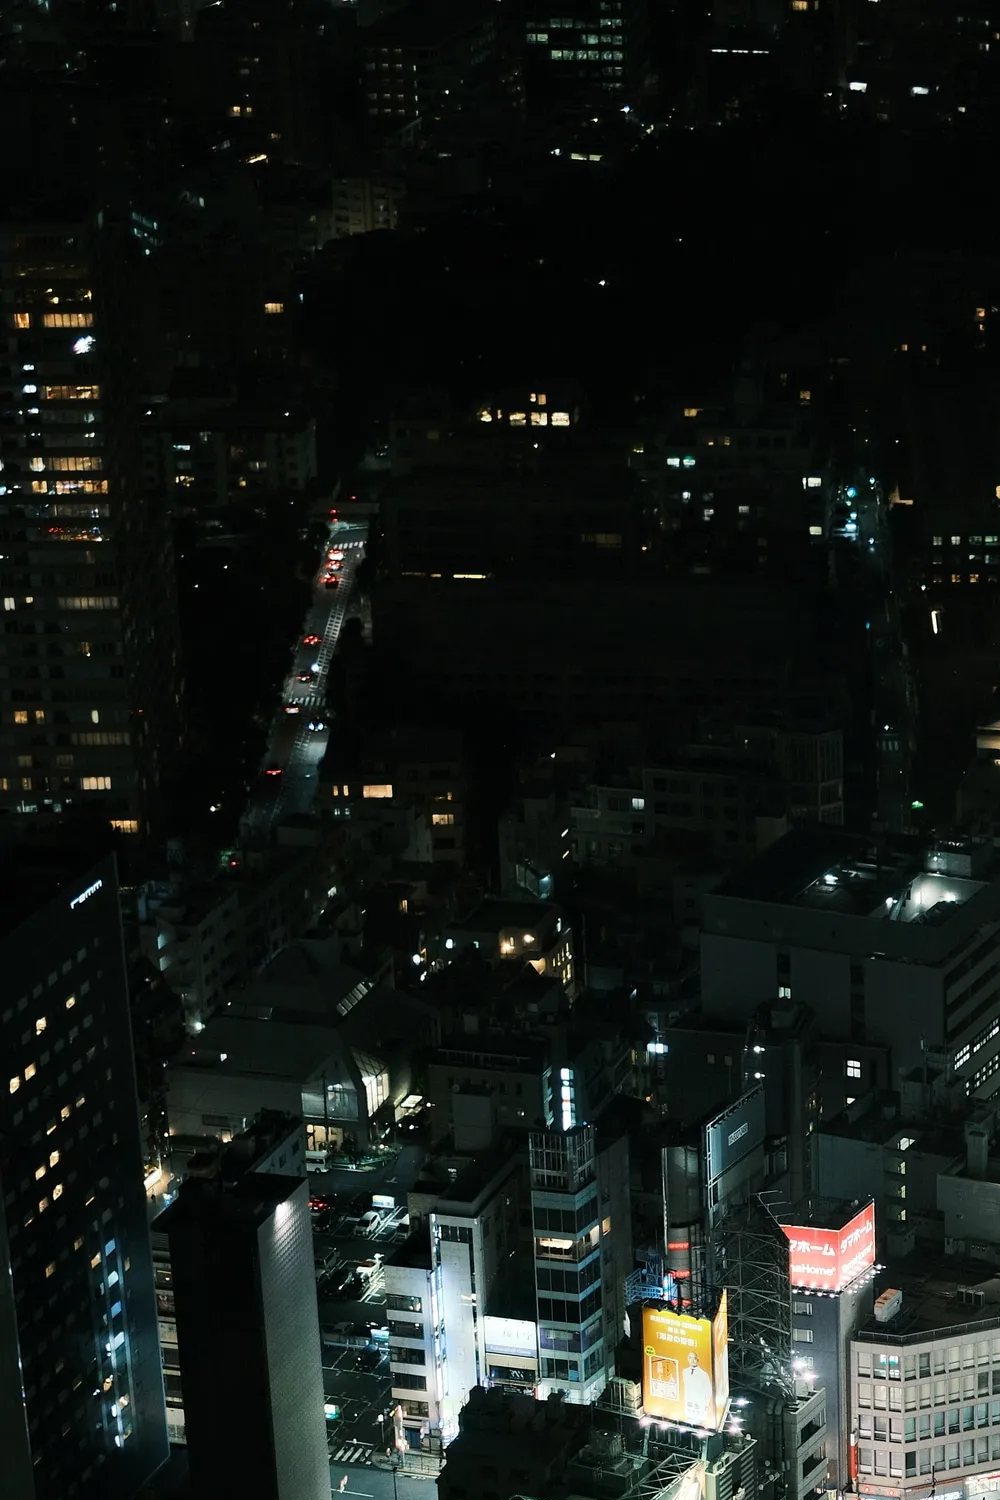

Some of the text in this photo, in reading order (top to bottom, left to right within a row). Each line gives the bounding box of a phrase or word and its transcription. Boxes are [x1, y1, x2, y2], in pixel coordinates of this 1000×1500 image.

[789, 1239, 836, 1257] マホーム
[840, 1220, 873, 1254] タマホーム
